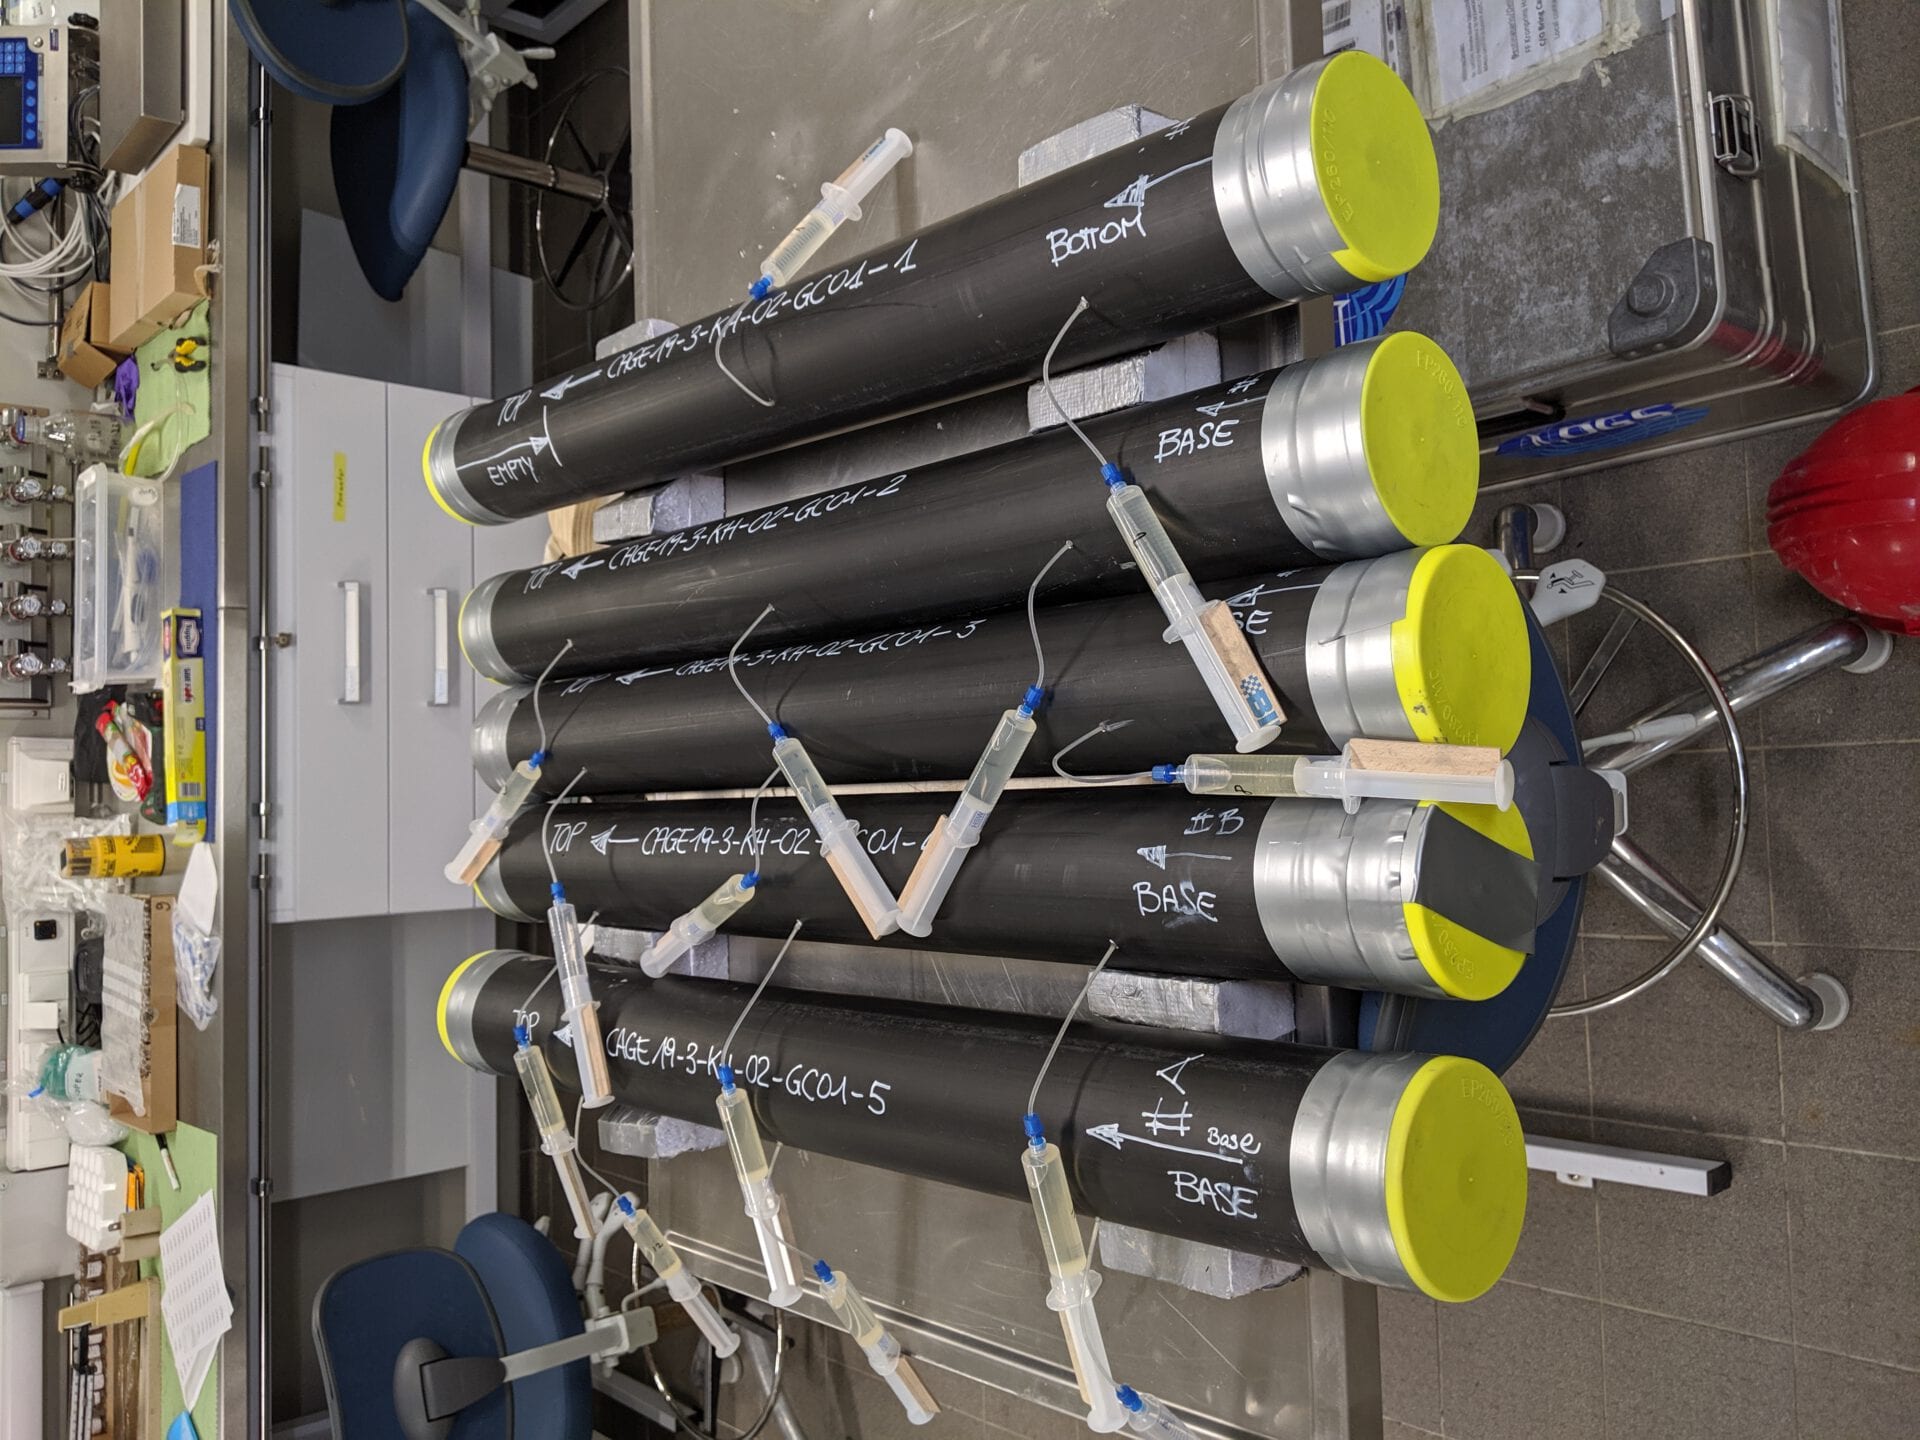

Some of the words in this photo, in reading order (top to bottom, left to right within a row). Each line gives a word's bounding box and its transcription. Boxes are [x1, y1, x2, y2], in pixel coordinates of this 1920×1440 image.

[497, 388, 532, 426] TOP
[1153, 419, 1240, 464] BASE
[487, 455, 540, 487] EMPTY
[522, 567, 563, 595] TOP
[548, 821, 588, 855] TOP
[1132, 880, 1219, 923] BASE
[1166, 1170, 1259, 1220] BASE
